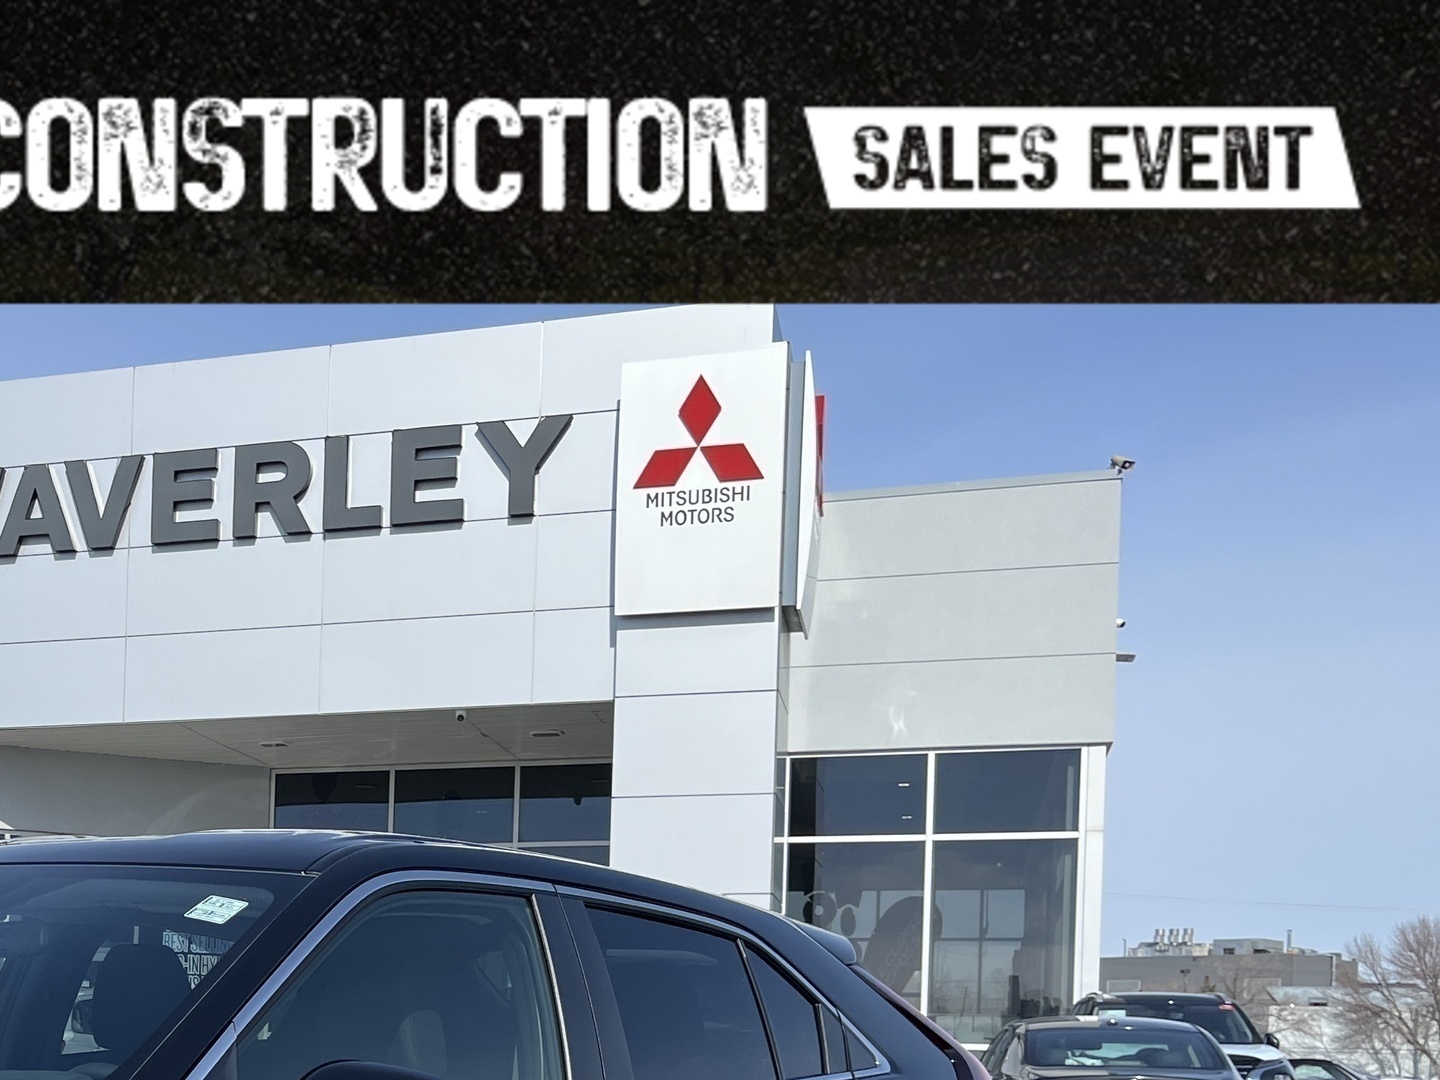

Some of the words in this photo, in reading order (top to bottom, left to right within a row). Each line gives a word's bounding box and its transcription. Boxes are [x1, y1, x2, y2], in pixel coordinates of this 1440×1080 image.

[646, 485, 750, 508] MITSUBISHI
[660, 506, 734, 527] MOTORS
[163, 932, 188, 952] BEST
